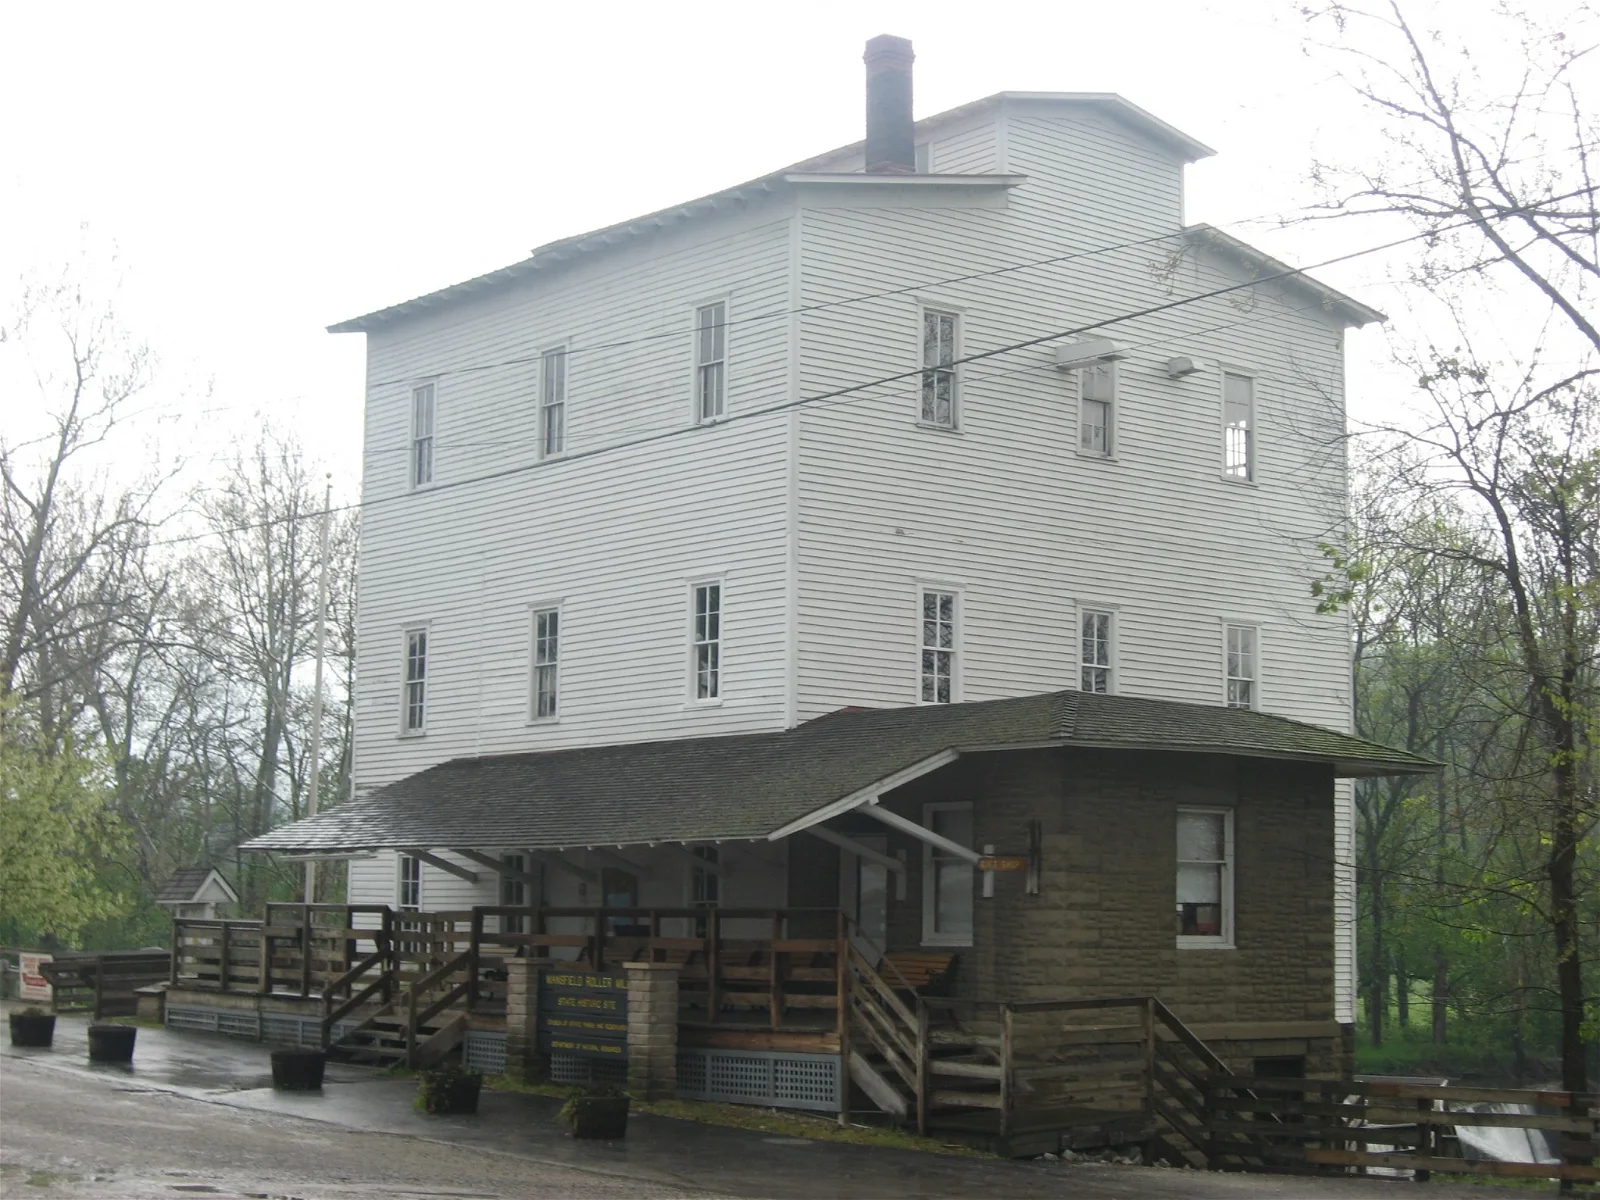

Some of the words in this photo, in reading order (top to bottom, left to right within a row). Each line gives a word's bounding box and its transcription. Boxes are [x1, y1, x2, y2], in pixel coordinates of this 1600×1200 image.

[1000, 860, 1020, 869] SHOP
[546, 975, 582, 987] MANSFIELD
[585, 976, 612, 988] ROLLER
[557, 997, 576, 1007] STATE
[577, 998, 601, 1009] HISTORIC
[602, 1000, 616, 1009] SITE
